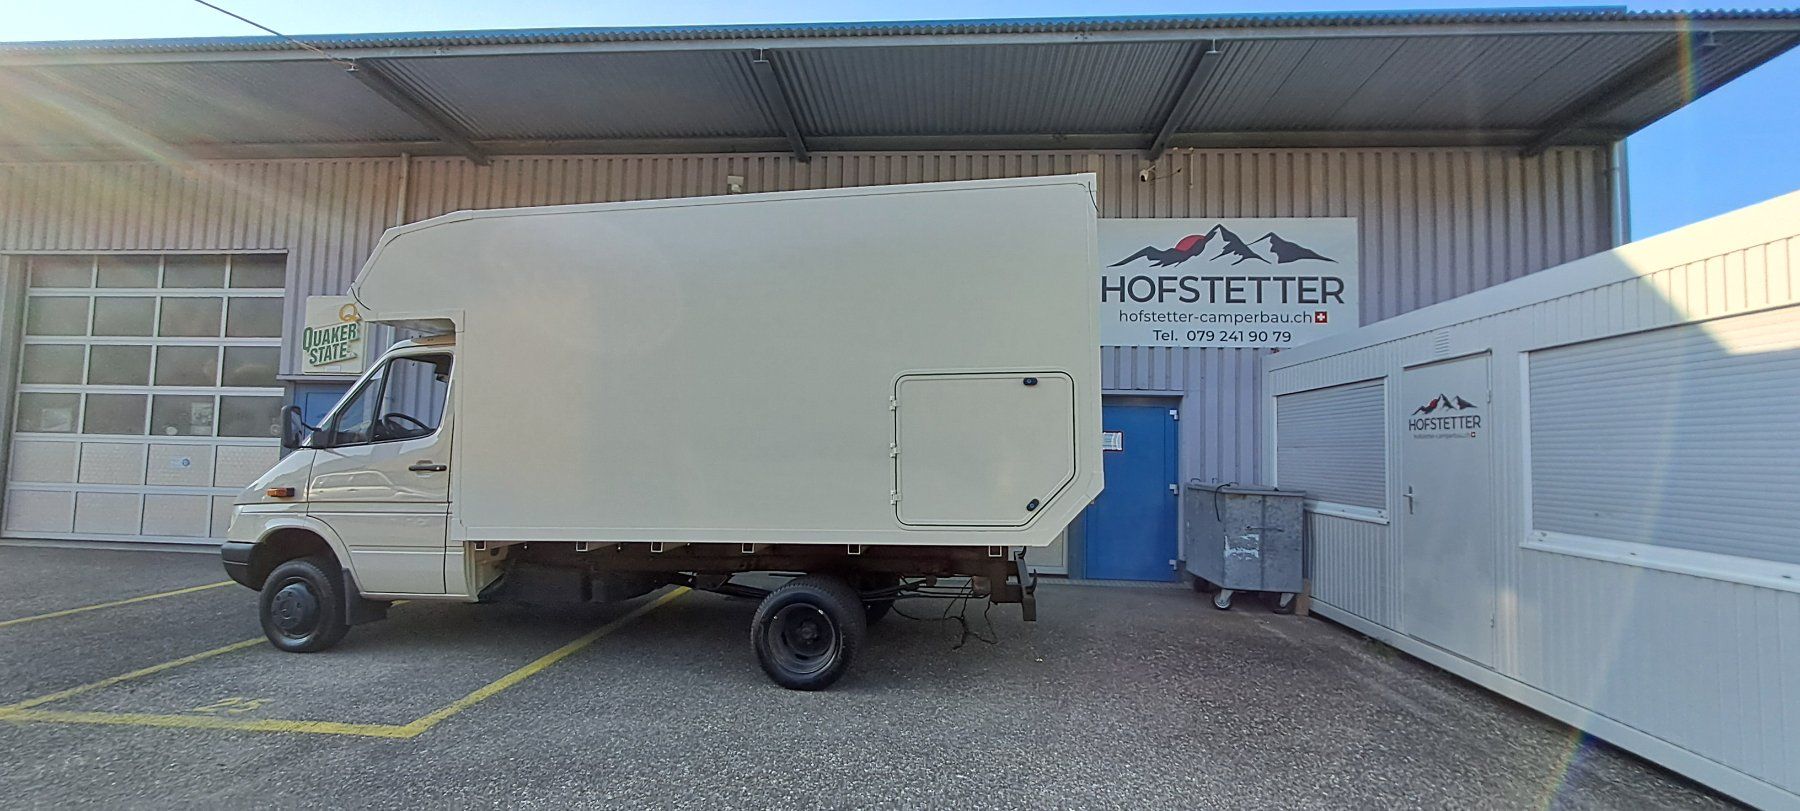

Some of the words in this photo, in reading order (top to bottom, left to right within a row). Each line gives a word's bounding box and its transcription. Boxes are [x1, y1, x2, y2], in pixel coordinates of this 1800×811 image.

[1101, 275, 1345, 304] HOFSTETTER
[1119, 310, 1312, 325] hofstetter-camperbau.ch
[303, 323, 357, 353] QUAKER
[1153, 330, 1178, 341] Tel.
[1186, 330, 1215, 341] 079
[1219, 330, 1244, 342] 241
[1248, 331, 1268, 342] 90
[1272, 331, 1292, 342] 79
[309, 342, 347, 364] STATE
[1408, 415, 1482, 431] HOFSTETTER
